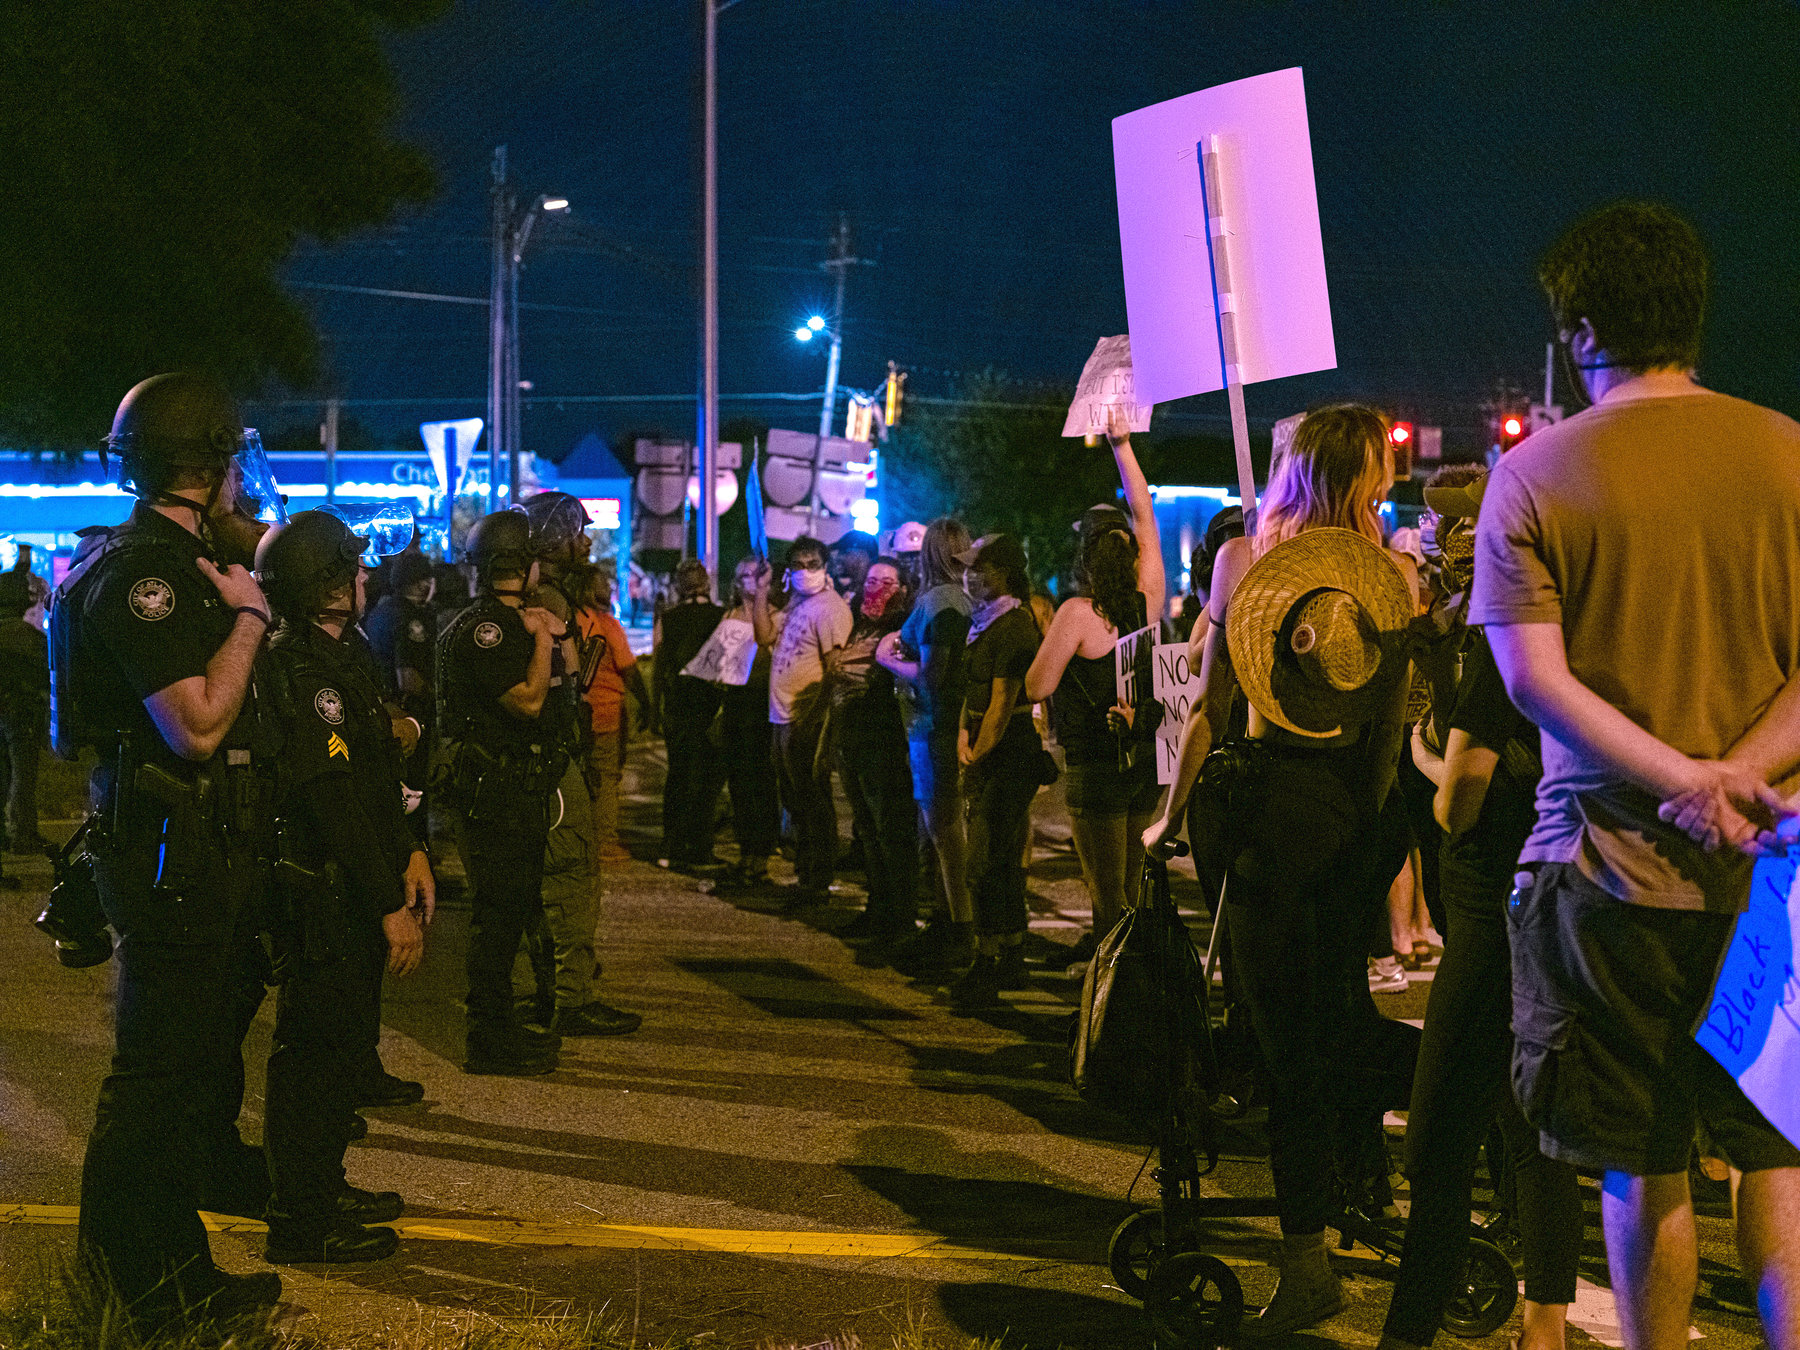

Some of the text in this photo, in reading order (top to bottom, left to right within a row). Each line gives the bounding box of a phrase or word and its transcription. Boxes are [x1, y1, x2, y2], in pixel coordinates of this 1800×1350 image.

[392, 463, 489, 482] Cheon
[137, 583, 145, 593] OF
[146, 580, 171, 599] ATLANTA
[142, 605, 169, 618] POLICE
[1158, 650, 1190, 688] NO
[1162, 694, 1189, 727] NO
[1165, 735, 1178, 773] N
[1707, 934, 1771, 1055] Black
